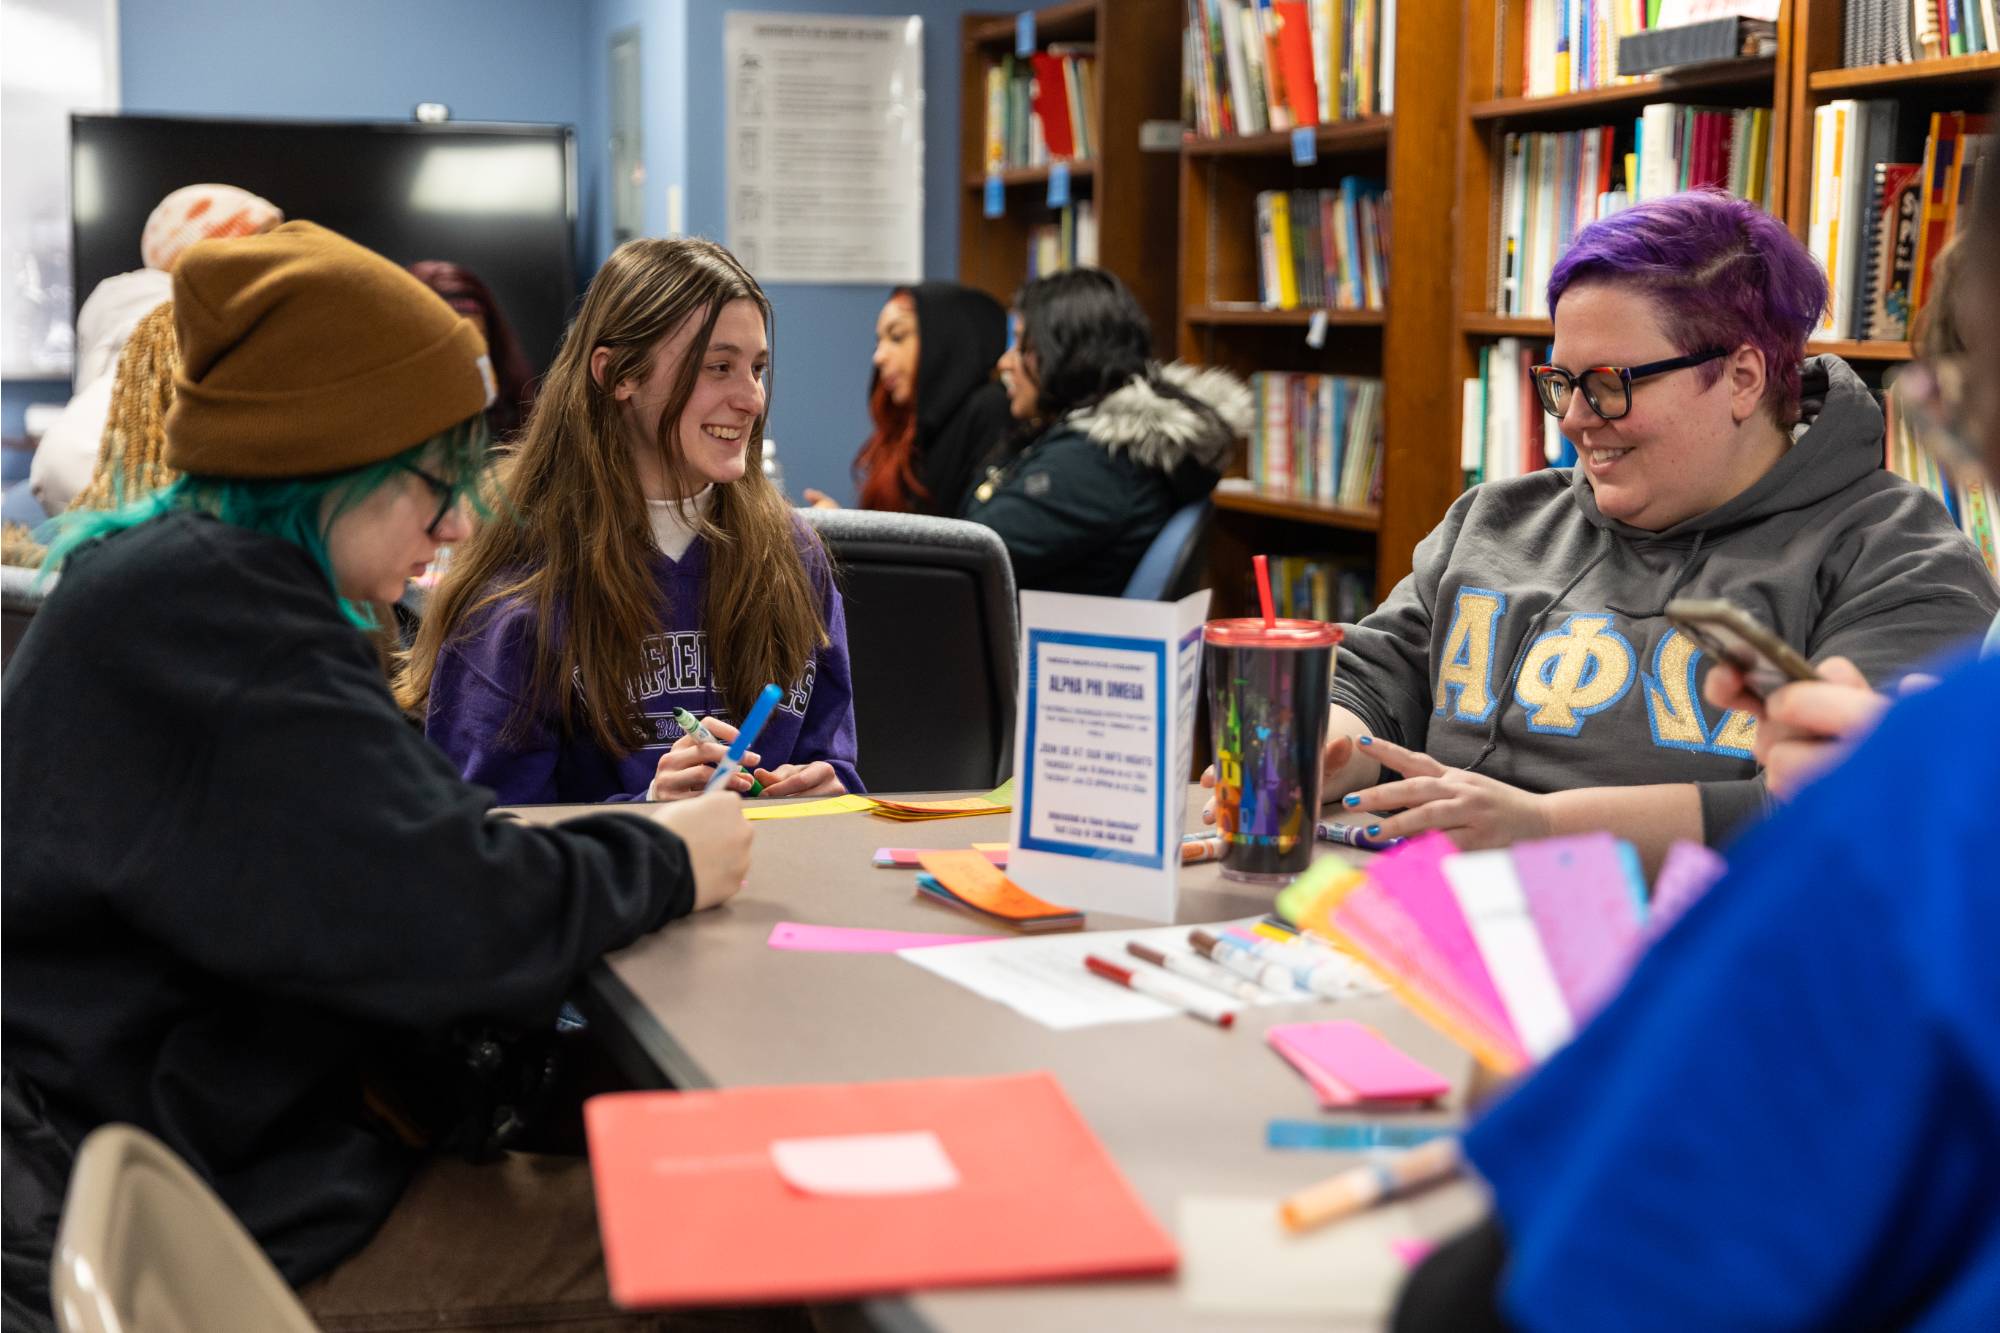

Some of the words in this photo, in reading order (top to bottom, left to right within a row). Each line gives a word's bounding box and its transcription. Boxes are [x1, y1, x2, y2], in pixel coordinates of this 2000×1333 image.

[1048, 673, 1082, 694] ALPHA
[1086, 677, 1104, 696] PHI
[1107, 680, 1144, 700] OMEGA
